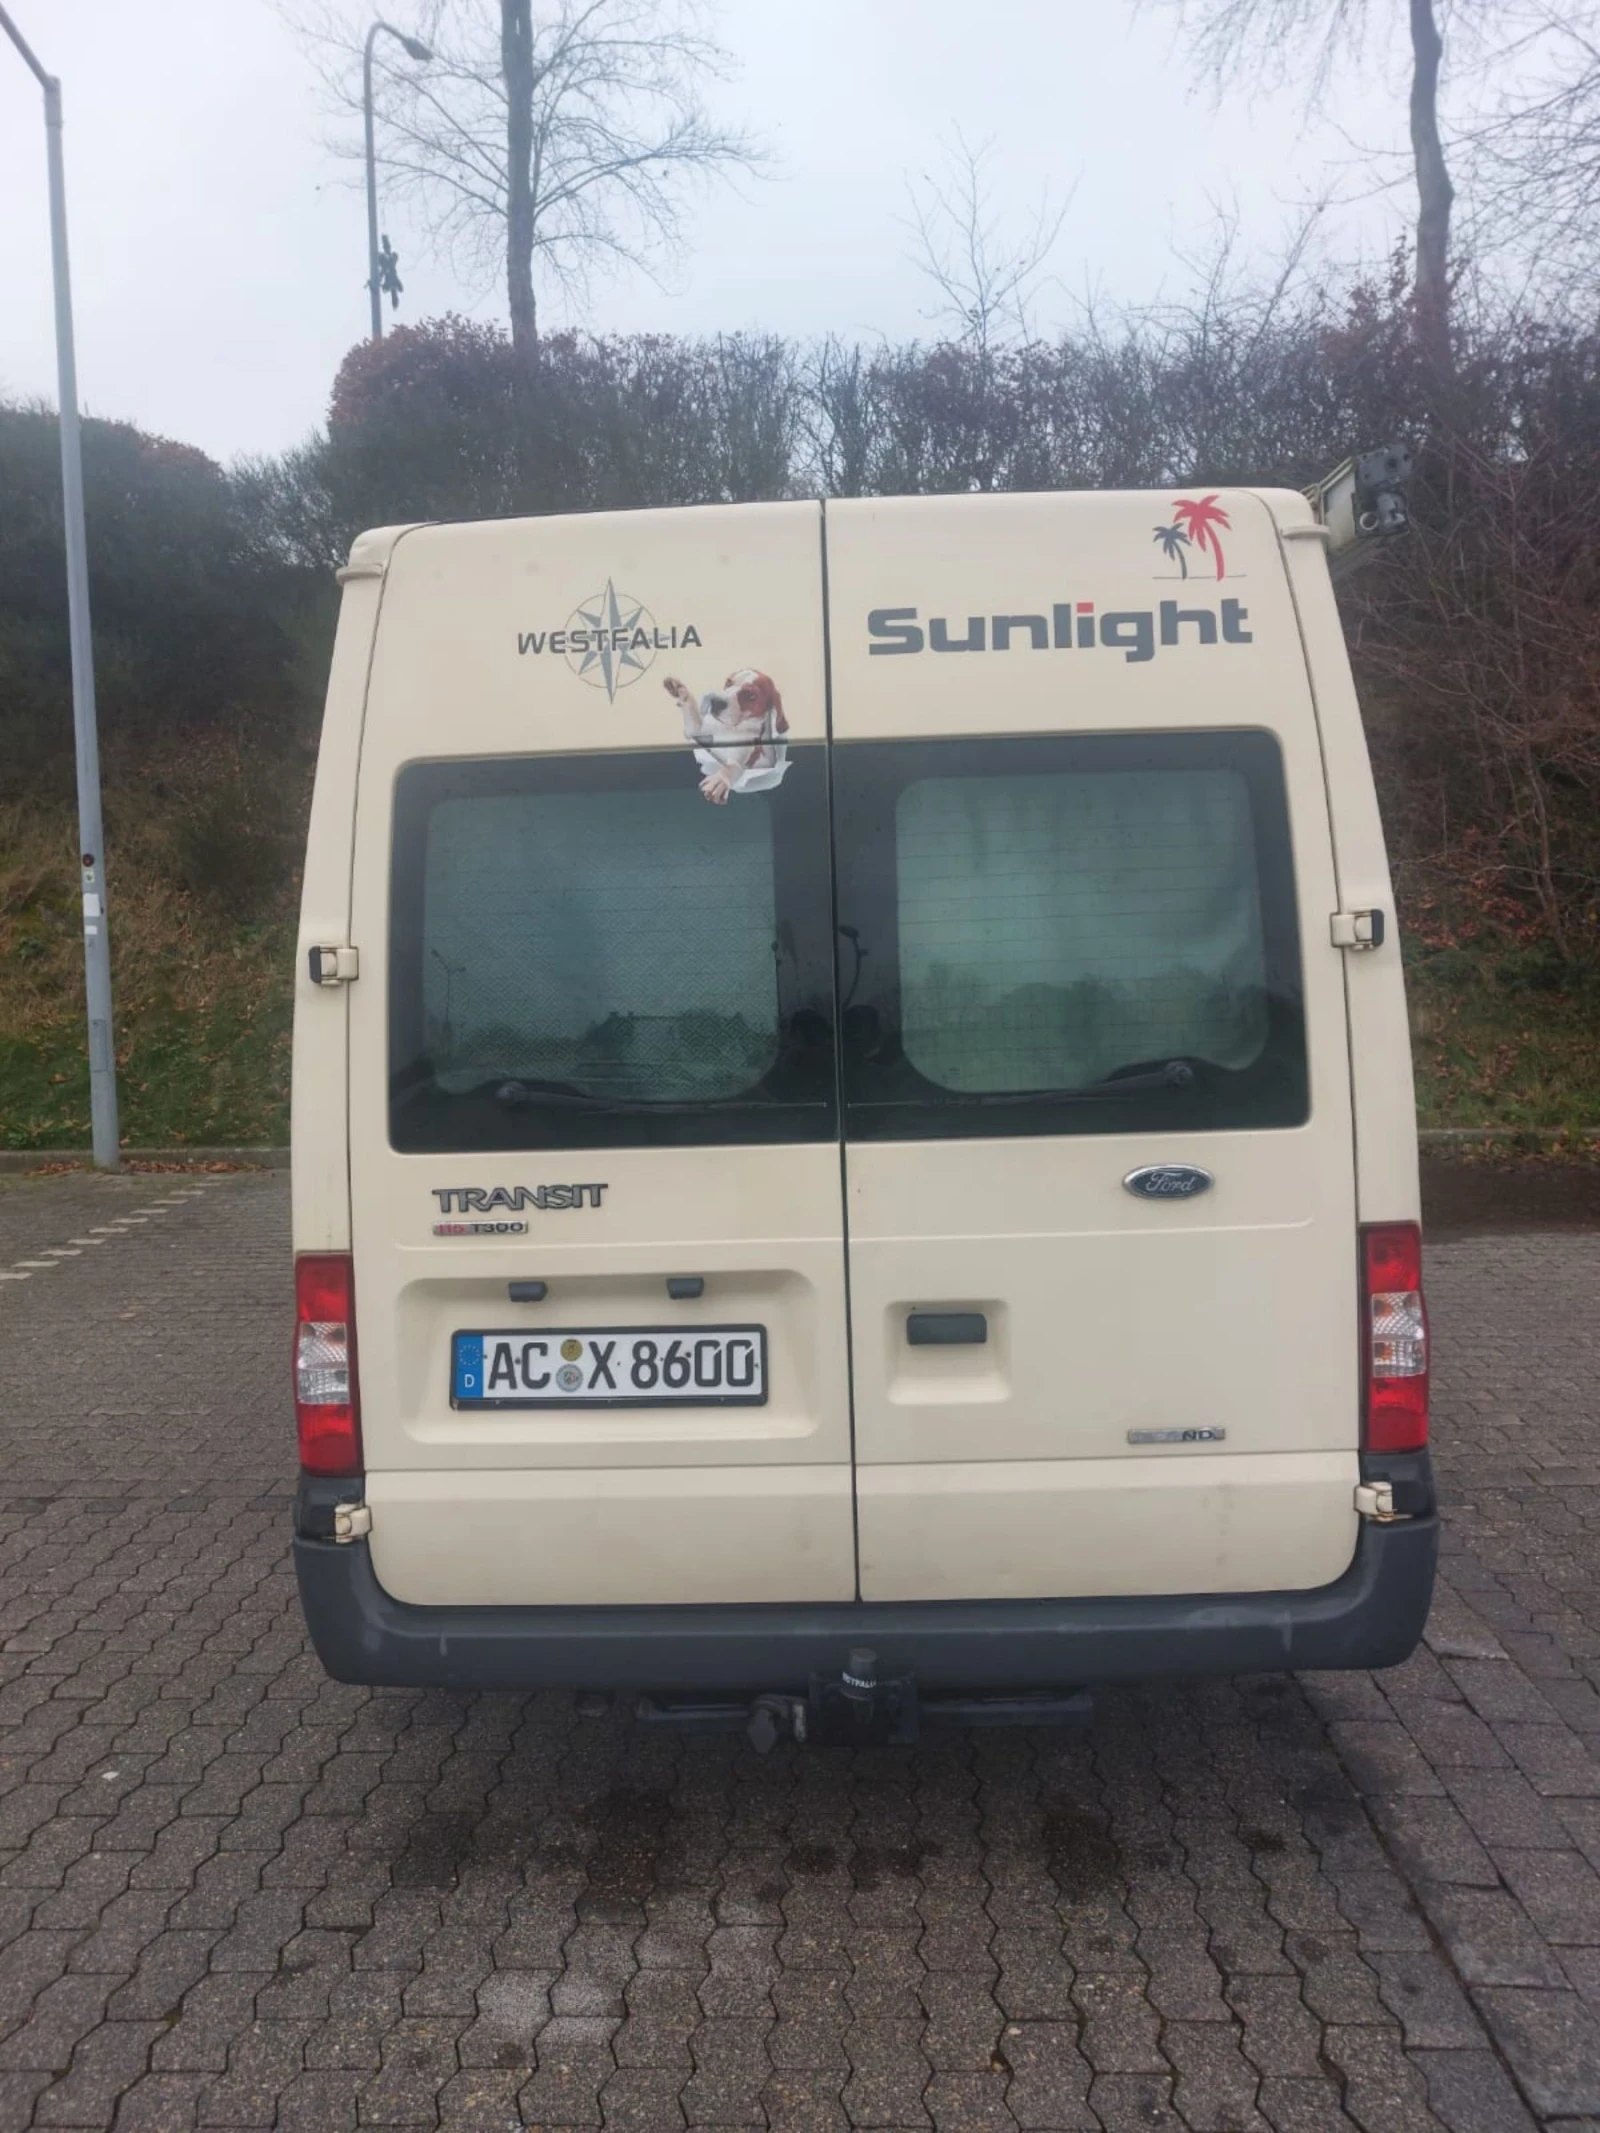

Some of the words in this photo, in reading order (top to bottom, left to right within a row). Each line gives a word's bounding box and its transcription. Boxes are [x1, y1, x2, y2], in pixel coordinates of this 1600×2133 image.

[517, 624, 703, 655] WESTFALIA
[867, 598, 1253, 663] Sunlight
[1145, 1170, 1196, 1192] Ford
[432, 1183, 609, 1214] TRANSIT
[471, 1222, 524, 1234] T300
[464, 1373, 475, 1388] D
[488, 1342, 550, 1390] AC
[587, 1341, 617, 1389] X
[631, 1339, 754, 1389] 8600
